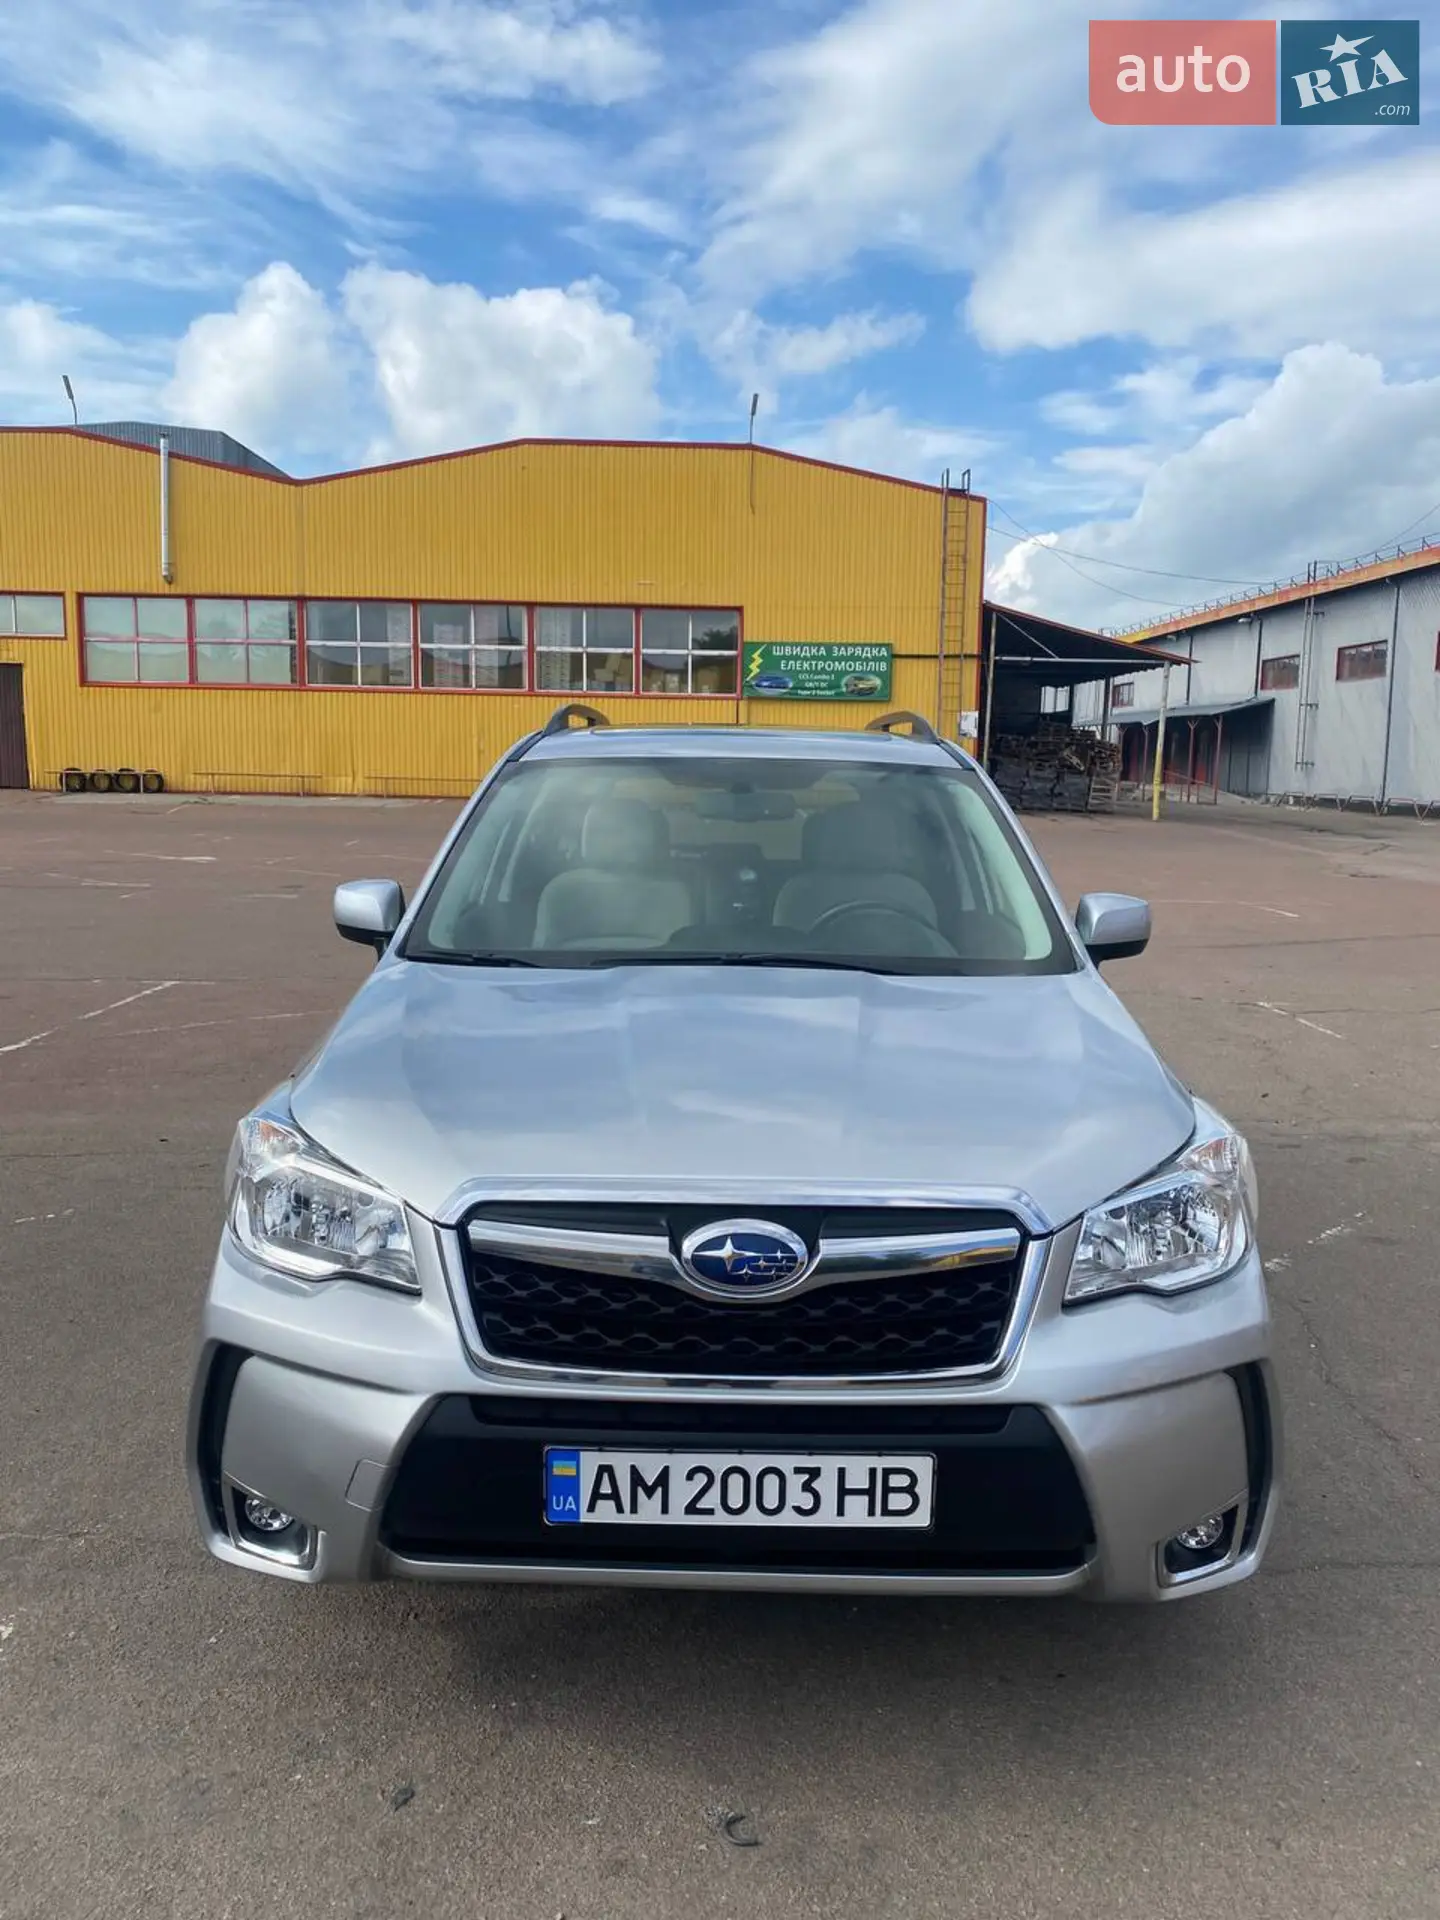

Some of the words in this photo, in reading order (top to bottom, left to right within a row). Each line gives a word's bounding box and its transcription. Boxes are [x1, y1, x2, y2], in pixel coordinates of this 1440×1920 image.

[772, 646, 827, 657] ШВИДКА
[832, 646, 888, 658] ЗАРЯДКА
[780, 660, 888, 672] ЕЛЕКТРОМОБІЛІВ
[586, 1464, 670, 1514] AM
[684, 1465, 822, 1517] 2003
[836, 1467, 920, 1517] HB
[552, 1495, 577, 1511] UA
